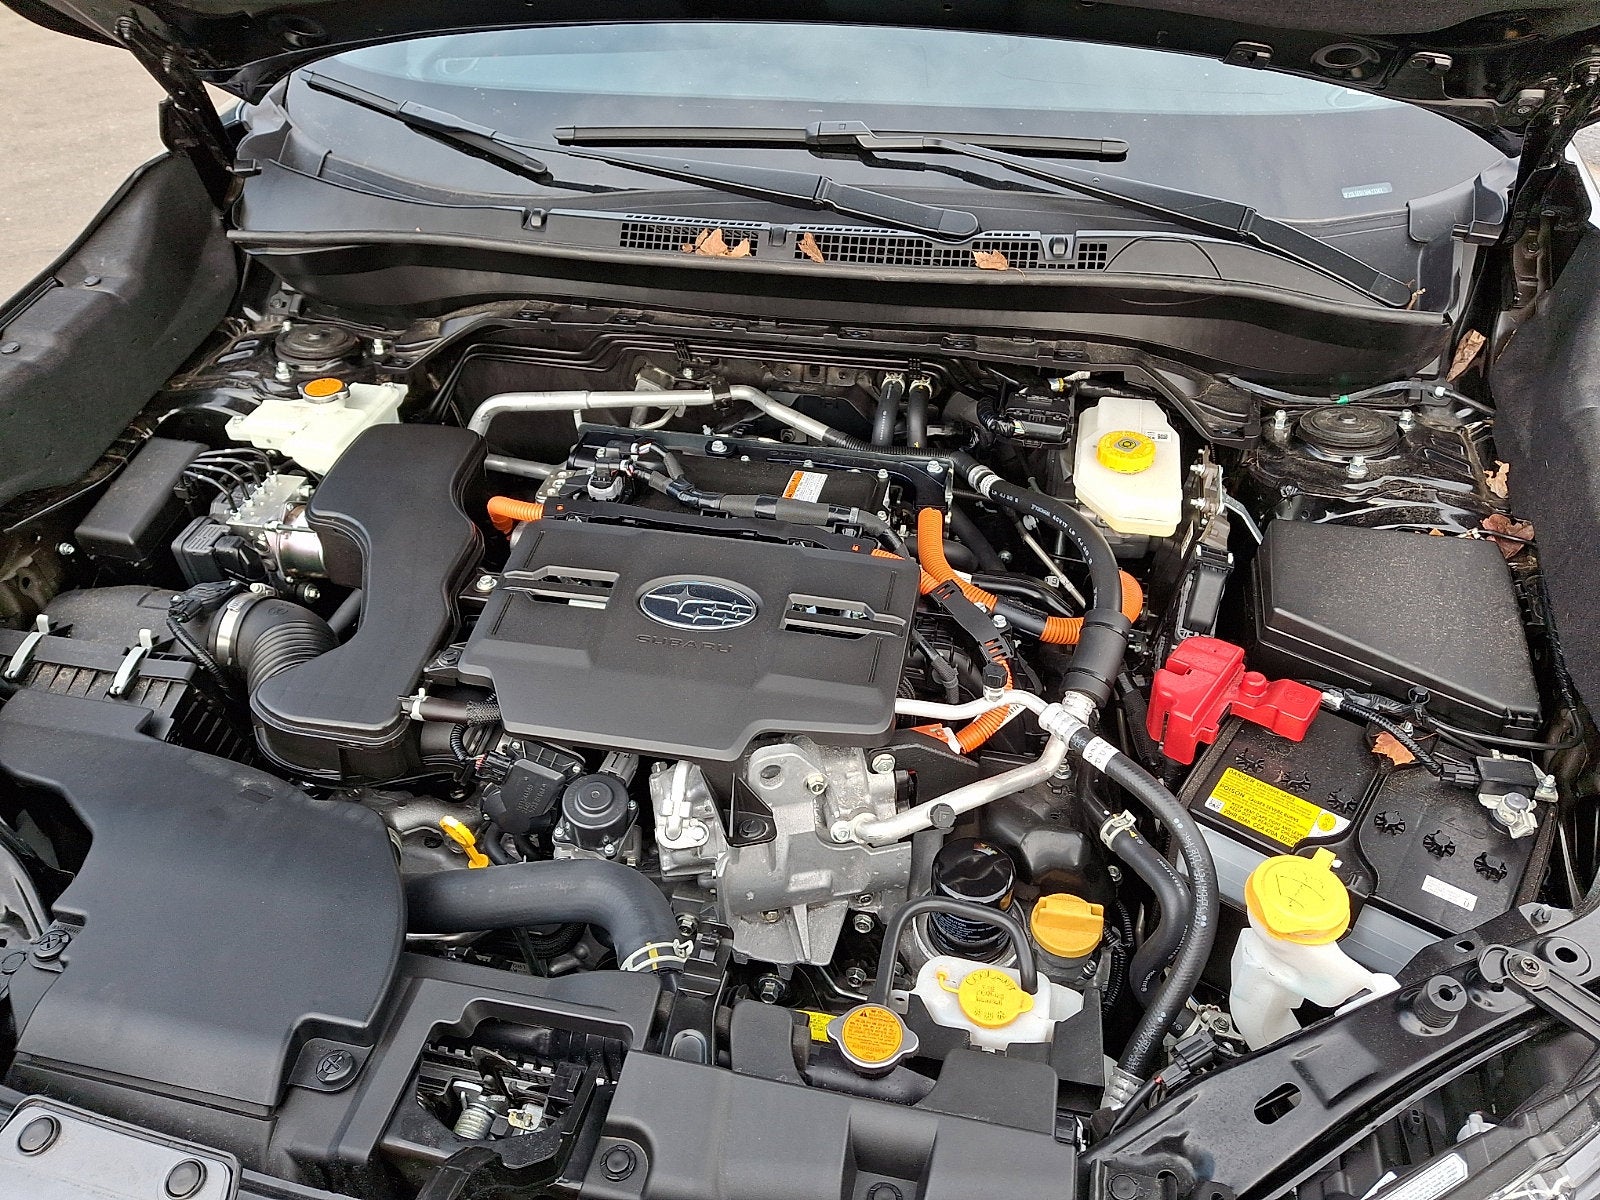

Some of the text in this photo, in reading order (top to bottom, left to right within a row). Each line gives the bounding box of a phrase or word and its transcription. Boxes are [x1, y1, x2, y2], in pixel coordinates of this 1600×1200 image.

[635, 634, 734, 654] SUBARU
[1228, 769, 1256, 783] DANGER
[1220, 783, 1245, 798] POISON
[1252, 822, 1265, 831] CCA
